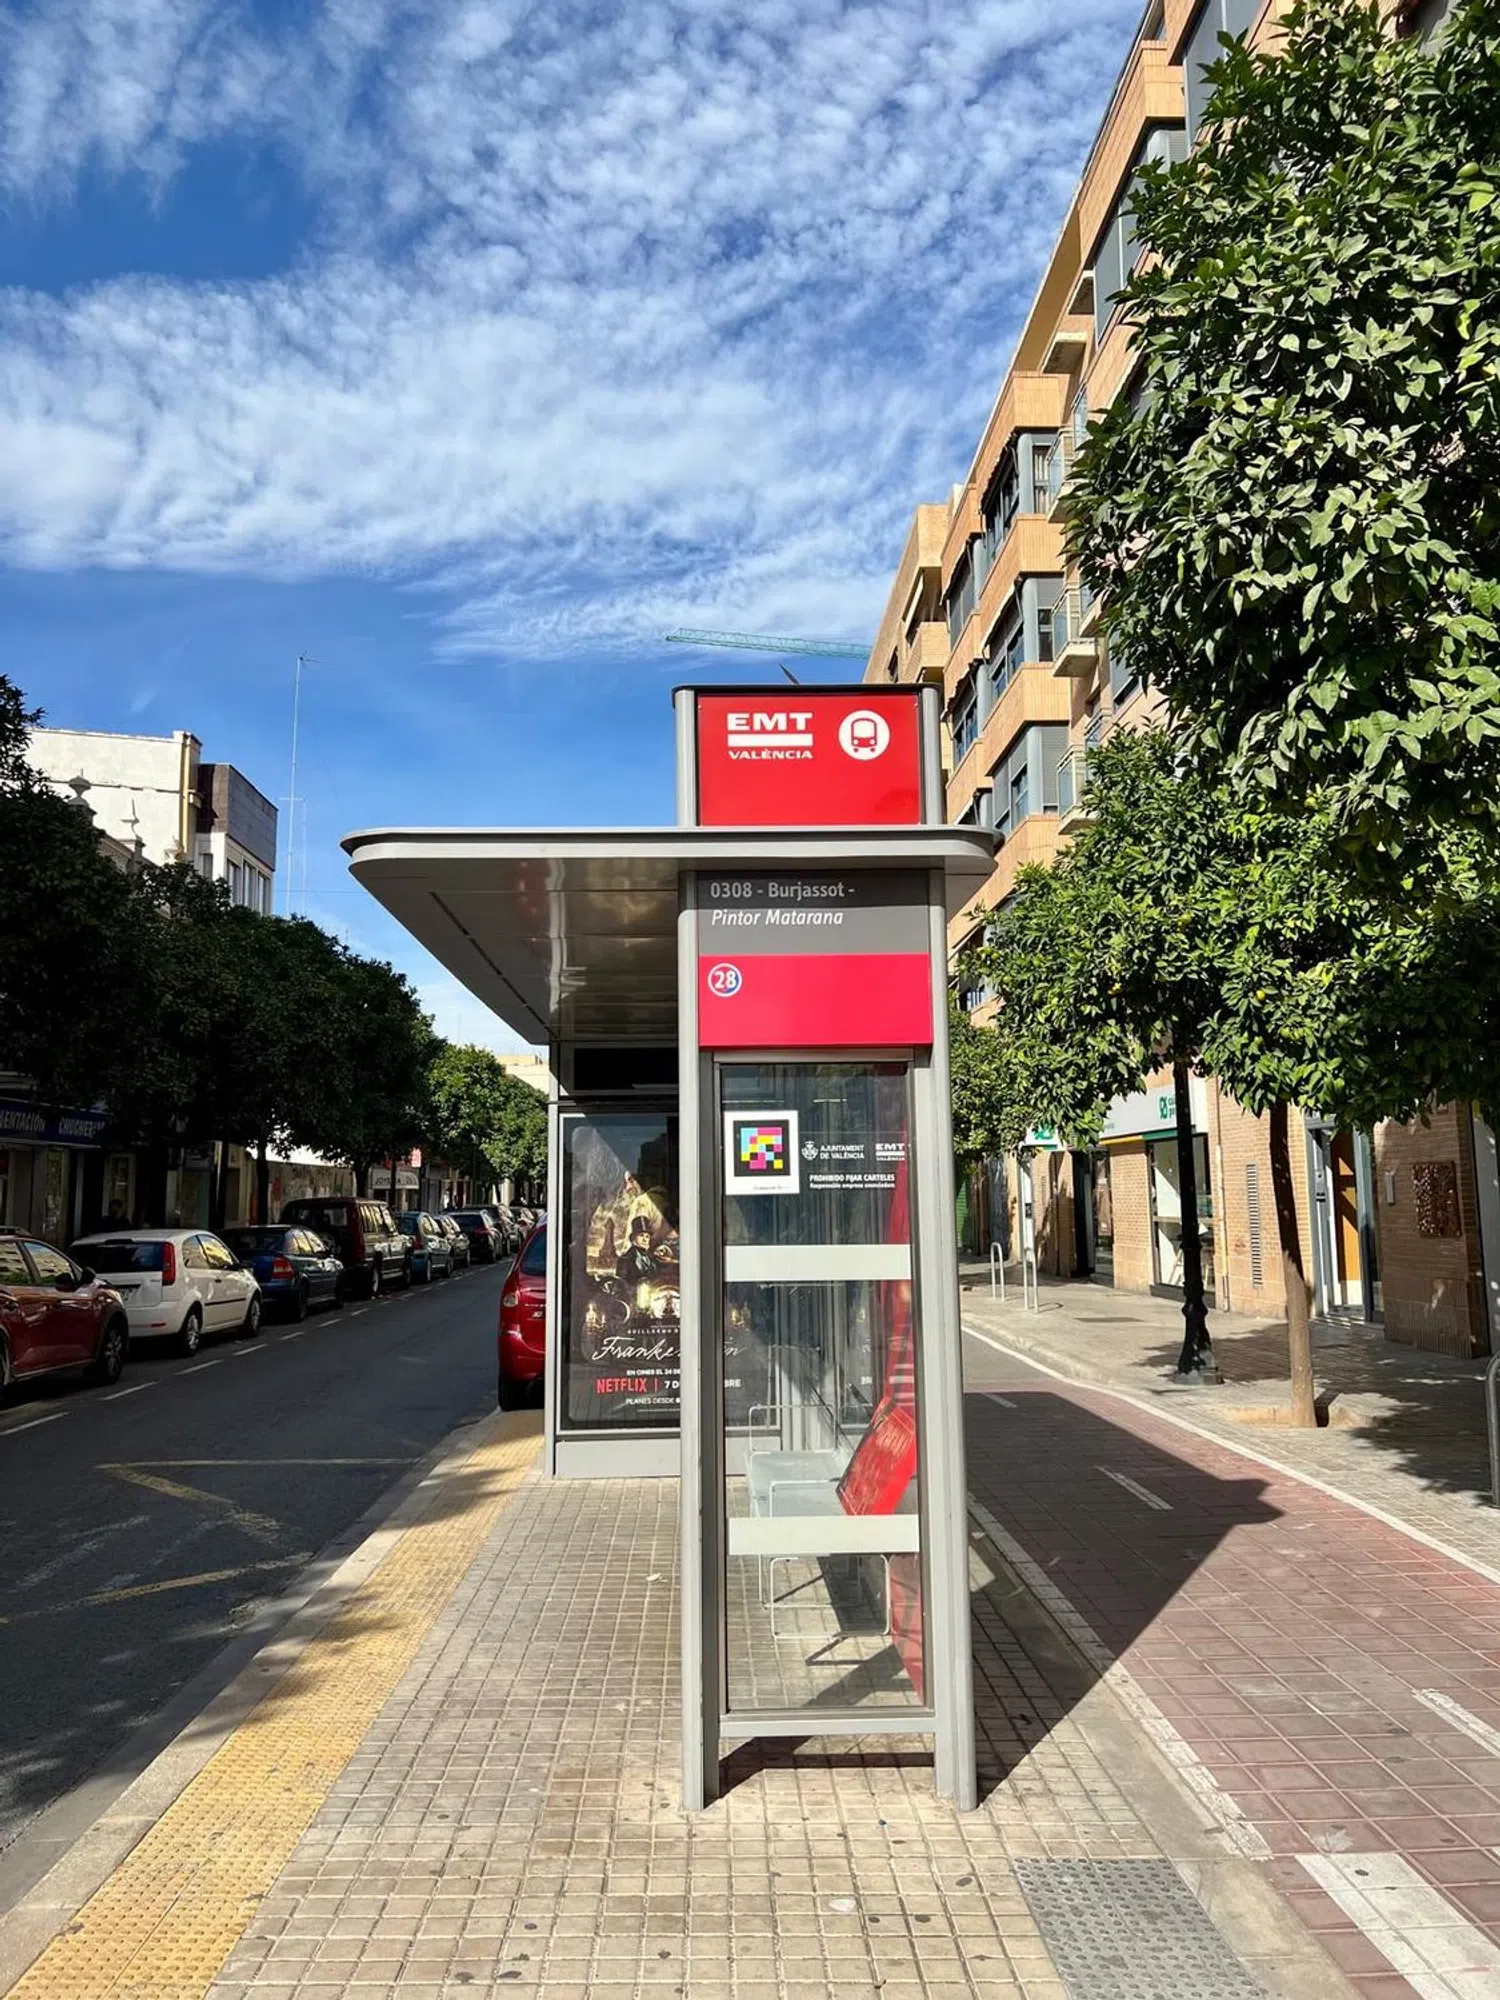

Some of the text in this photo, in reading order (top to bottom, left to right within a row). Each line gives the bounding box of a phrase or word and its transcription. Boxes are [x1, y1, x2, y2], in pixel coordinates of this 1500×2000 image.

[727, 712, 813, 731] EMT
[710, 882, 752, 898] 0308
[768, 881, 845, 901] Burjassot
[711, 909, 843, 926] Pintor Matarana
[714, 970, 736, 989] 28
[820, 1144, 865, 1152] AJUNTAMENT
[875, 1143, 905, 1151] EMT
[846, 1174, 862, 1182] FIJAR
[596, 1377, 647, 1394] NETFLIX
[664, 1380, 671, 1389] 7
[625, 1397, 652, 1405] PLANES
